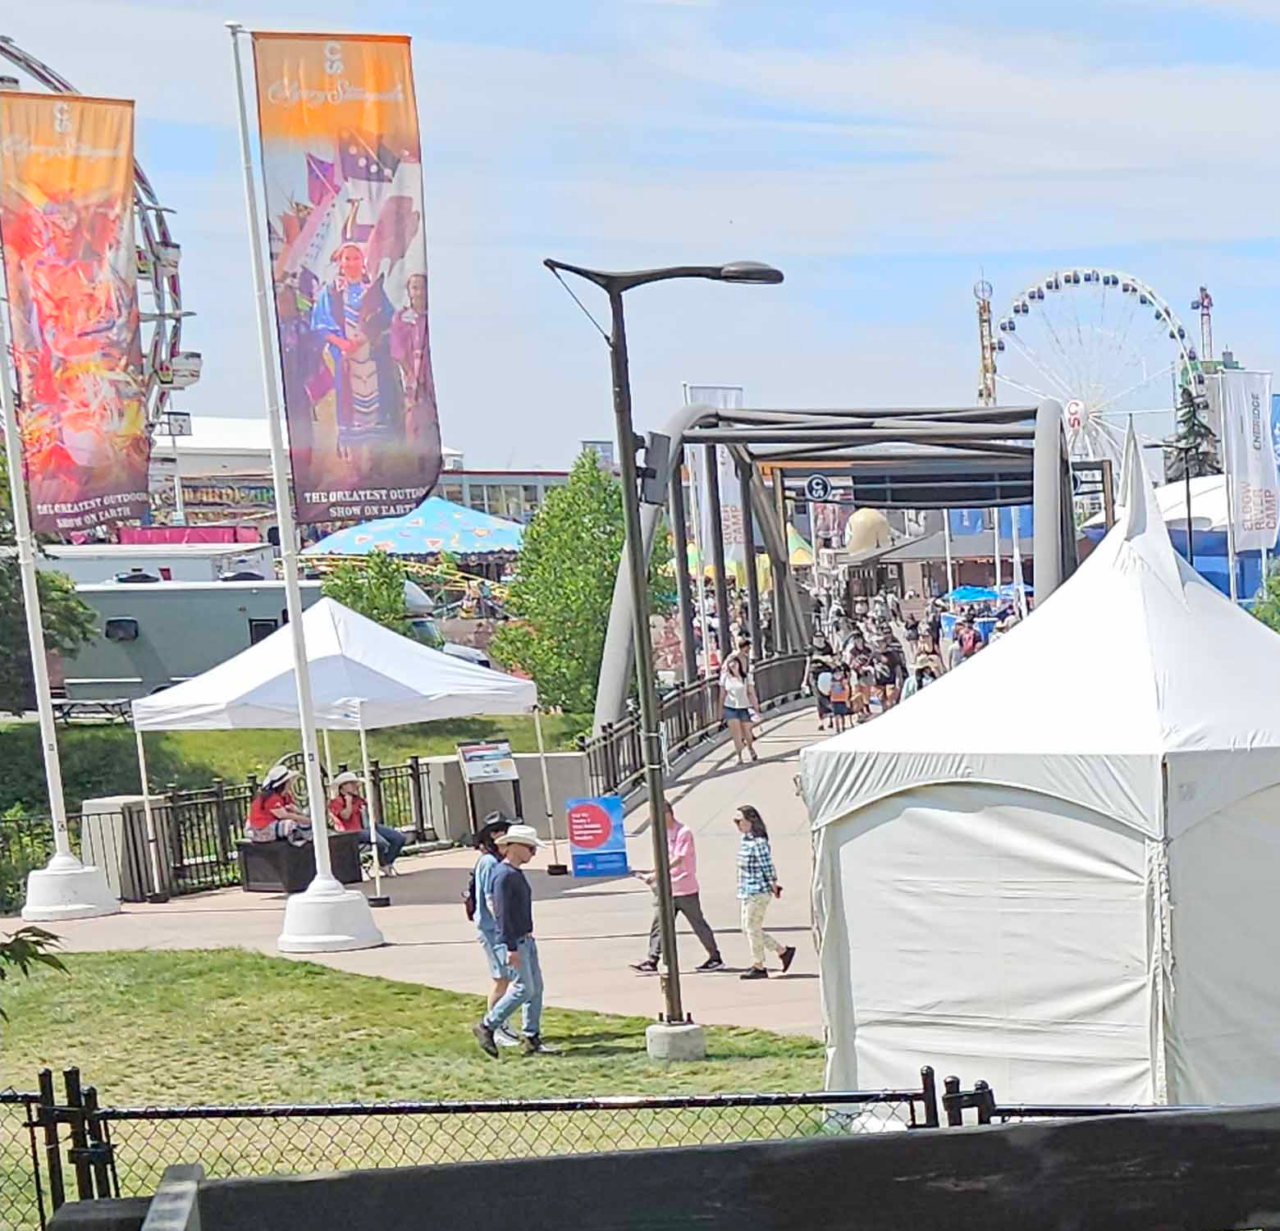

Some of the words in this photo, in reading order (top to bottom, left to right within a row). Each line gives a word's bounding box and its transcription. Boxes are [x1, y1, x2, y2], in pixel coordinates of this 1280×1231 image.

[304, 492, 328, 504] THE
[329, 489, 388, 502] GREATEST
[390, 485, 430, 500] OUTDO
[54, 498, 102, 513] GREATEST
[329, 506, 362, 517] SHOW
[364, 505, 379, 516] ON
[1253, 488, 1265, 531] RIVER
[1264, 489, 1277, 530] CAMP
[84, 513, 97, 524] ON
[98, 507, 131, 520] EARTH
